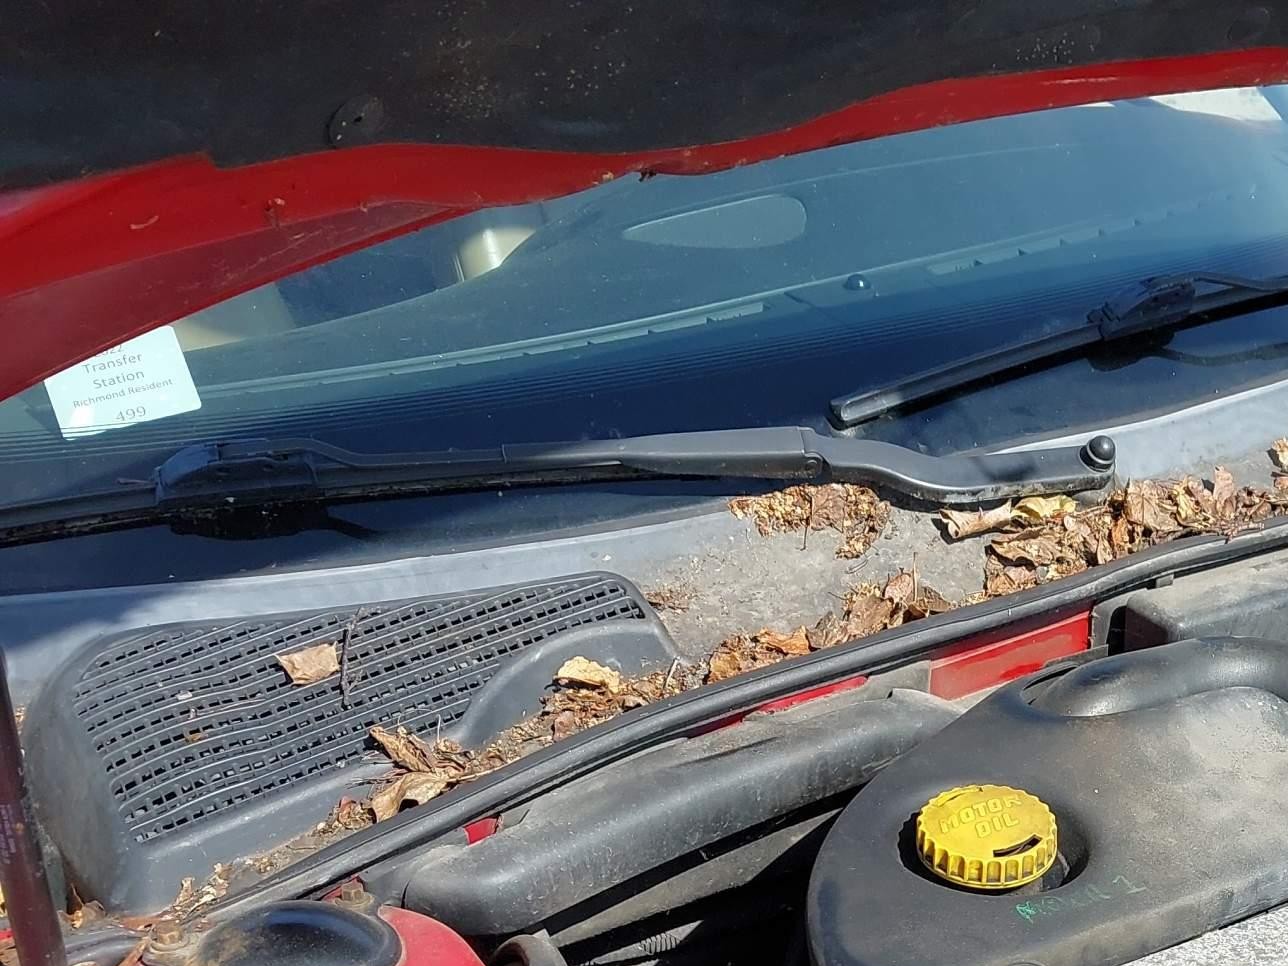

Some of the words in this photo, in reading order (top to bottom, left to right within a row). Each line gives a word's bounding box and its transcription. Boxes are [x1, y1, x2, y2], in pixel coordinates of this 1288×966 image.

[83, 353, 143, 373] Transfer
[93, 370, 145, 389] Station
[73, 389, 126, 408] Richmond
[128, 378, 173, 394] Resident
[116, 406, 147, 422] 499
[938, 793, 1023, 834] MOTOR
[974, 814, 1021, 839] OIL
